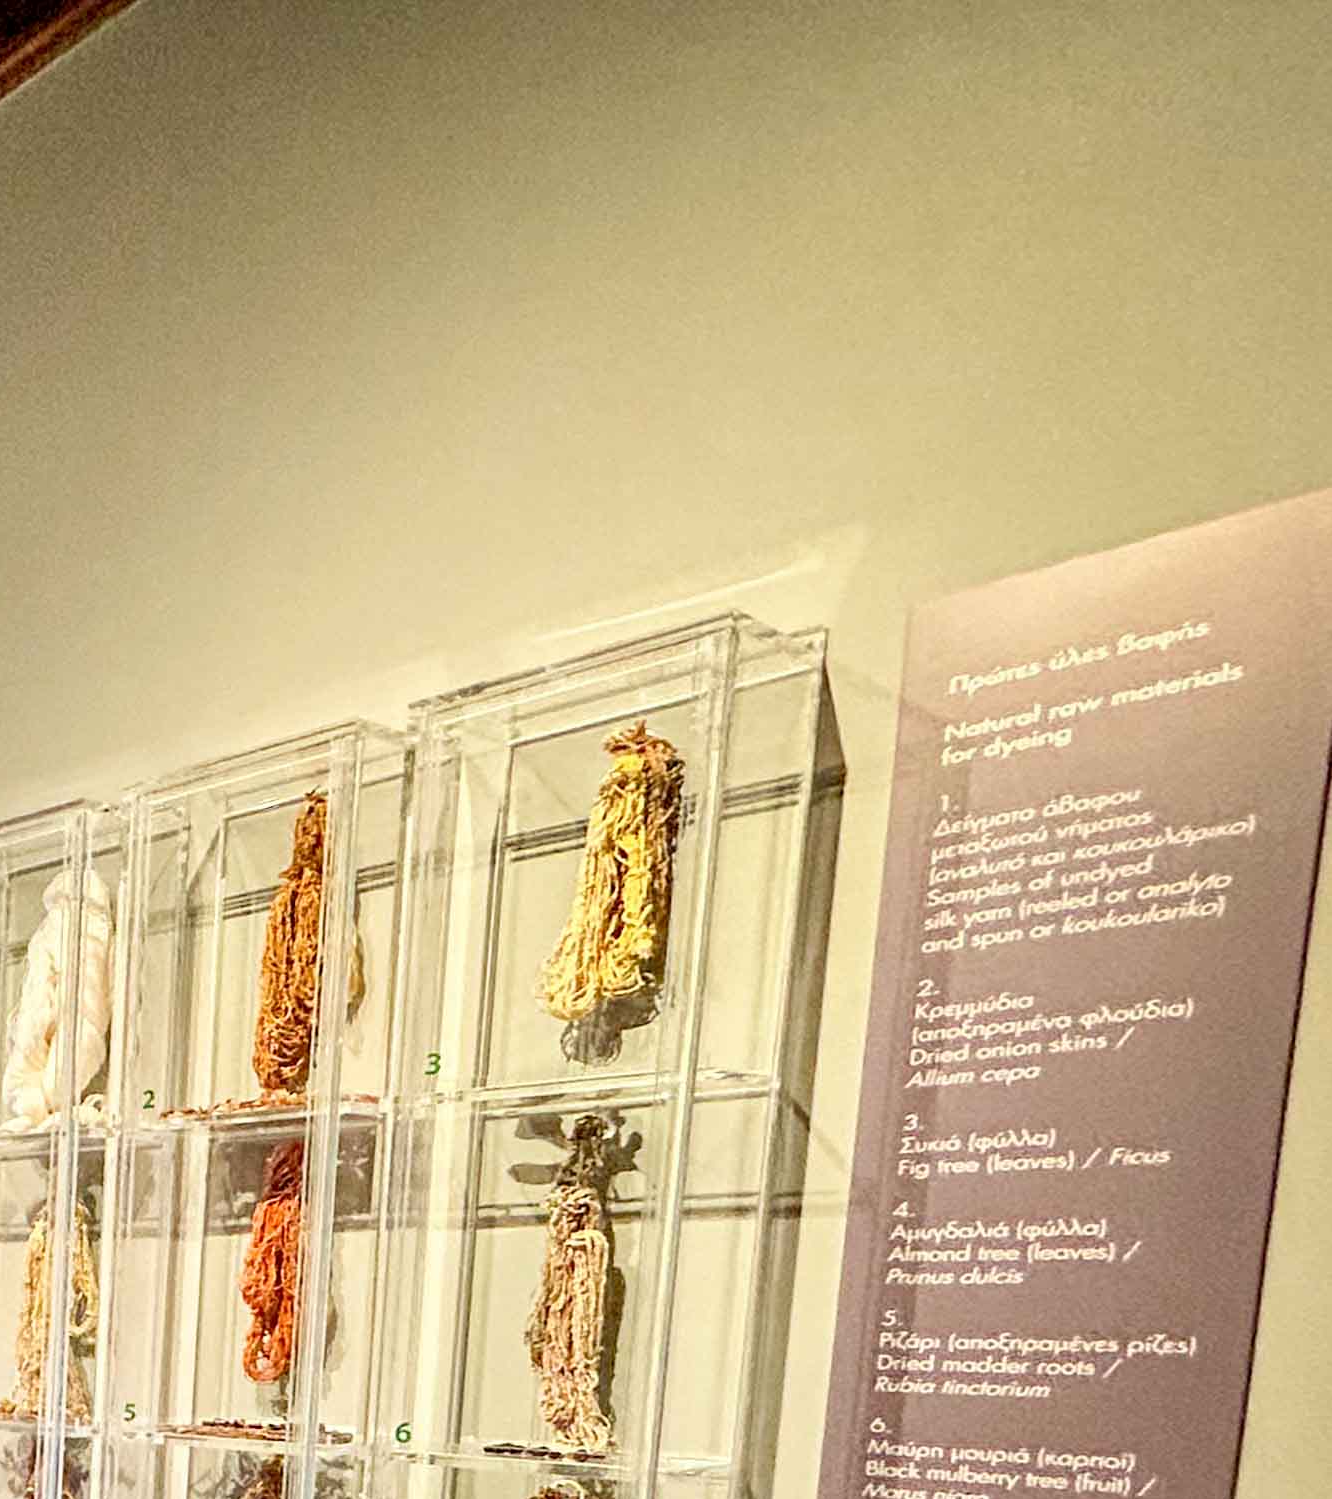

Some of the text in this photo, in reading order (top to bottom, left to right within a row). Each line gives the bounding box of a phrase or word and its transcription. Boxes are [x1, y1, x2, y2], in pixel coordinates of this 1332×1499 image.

[944, 663, 1244, 742] Natural raw materials
[941, 728, 1071, 767] for dyeing
[941, 795, 959, 811] 1.
[927, 855, 1153, 907] Samples of undyed
[925, 873, 1233, 931] silk yarn (reeled or analyto
[921, 895, 1226, 954] and spun or koukoulariko)
[917, 979, 939, 997] 2.
[910, 1043, 969, 1066] Dried
[976, 1039, 1041, 1060] onion
[1049, 1033, 1107, 1053] skins
[424, 1052, 441, 1076] 3
[905, 1066, 1041, 1089] Allium cepa
[142, 1089, 155, 1110] 2
[903, 1114, 923, 1131] 3.
[898, 1159, 929, 1180] Fig
[938, 1160, 979, 1174] tree
[987, 1149, 1075, 1175] (leaves)
[1109, 1147, 1170, 1166] Ficus
[893, 1202, 915, 1217] 4.
[887, 1243, 971, 1263] Almond
[978, 1247, 1019, 1262] tree
[1028, 1242, 1116, 1263] (leaves)
[885, 1267, 1023, 1285] Prunus dulcis
[882, 1310, 903, 1327] 5.
[877, 1354, 935, 1372] Dried
[942, 1355, 1029, 1374] madder
[1037, 1361, 1095, 1376] roots
[875, 1377, 1051, 1398] Rubia tinctorium
[123, 1403, 136, 1422] 5
[395, 1421, 412, 1444] 6
[870, 1417, 891, 1433] 6.
[866, 1460, 920, 1479] Black
[927, 1465, 1019, 1490] mulberry
[1026, 1472, 1068, 1490] tree
[1075, 1473, 1130, 1496] (fruit)
